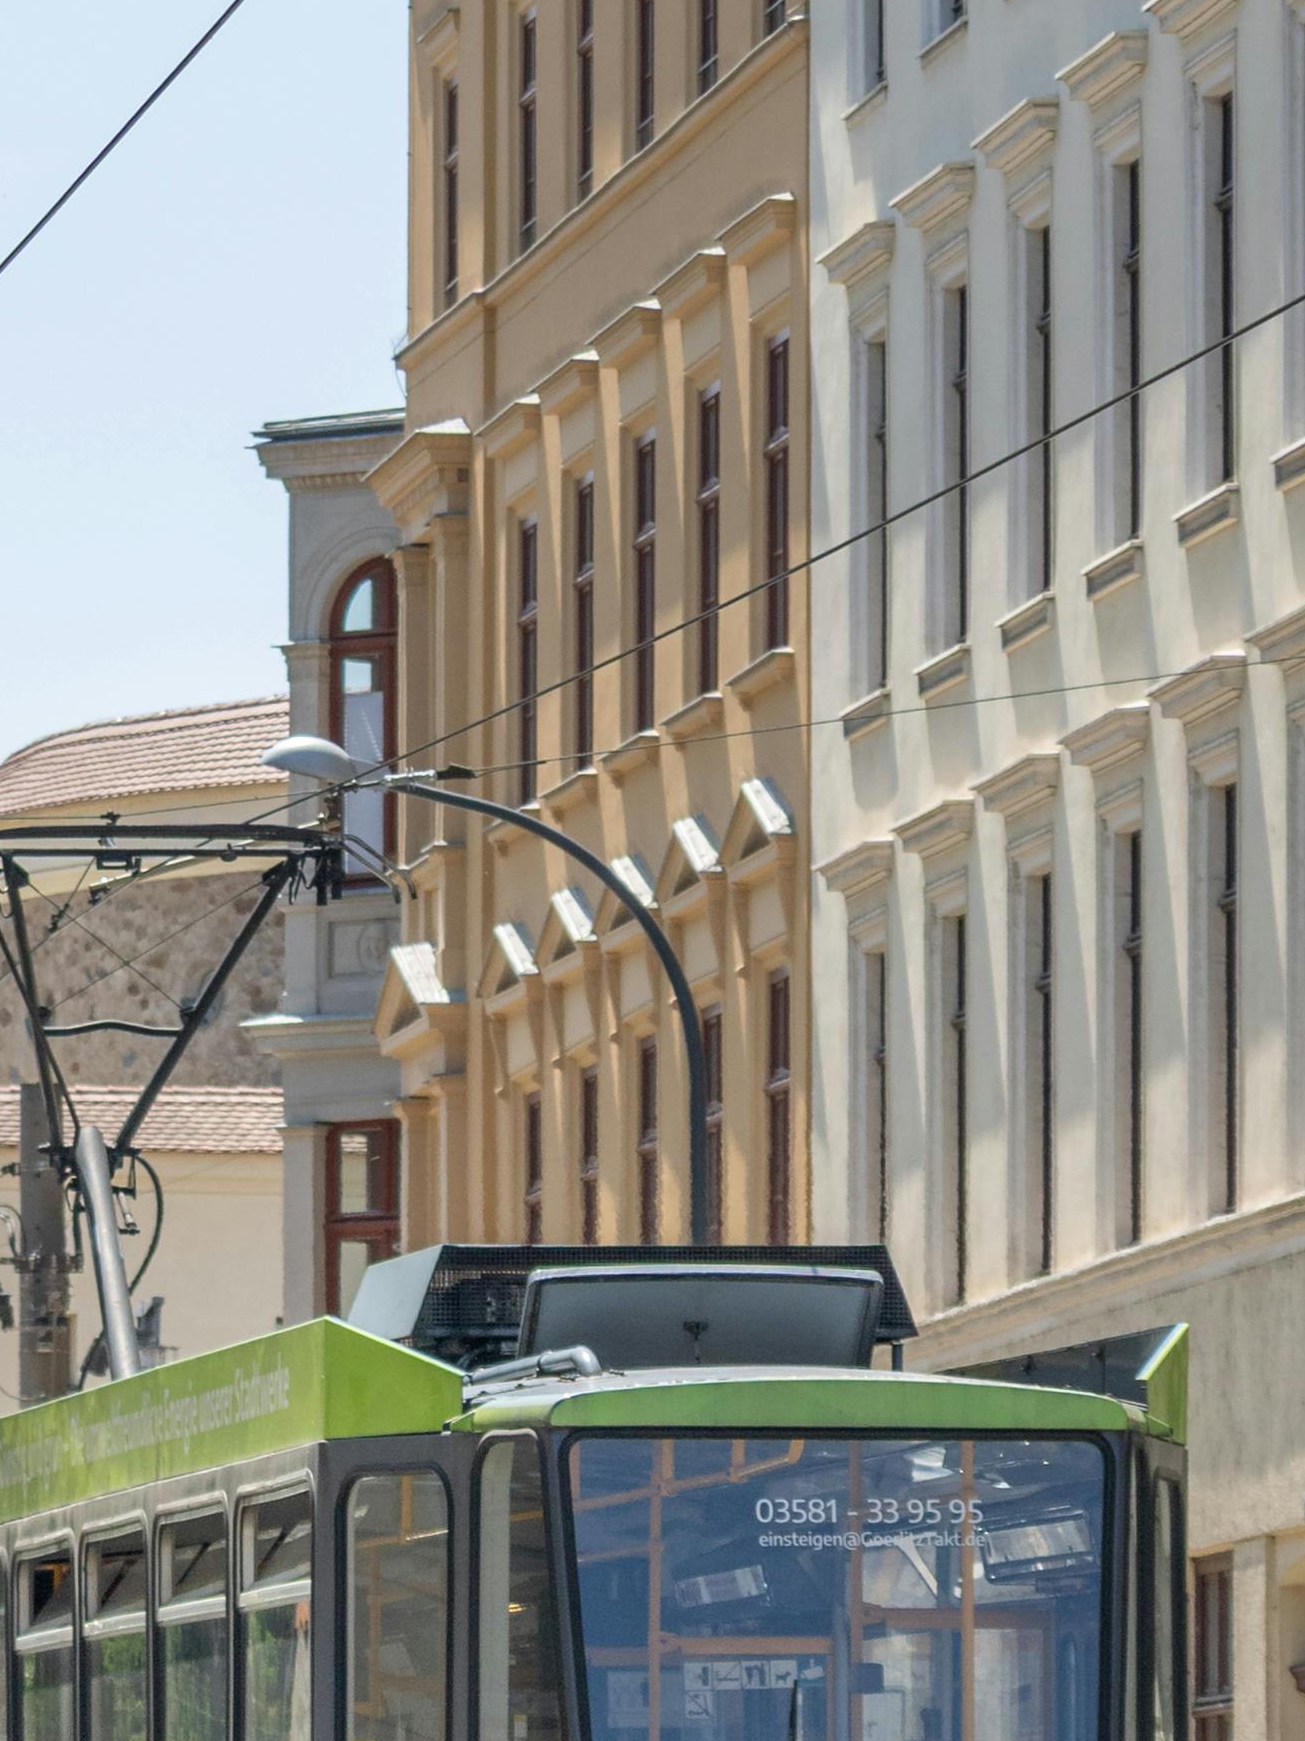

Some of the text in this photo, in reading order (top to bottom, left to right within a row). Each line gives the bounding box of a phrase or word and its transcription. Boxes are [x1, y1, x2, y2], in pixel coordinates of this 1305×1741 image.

[755, 1498, 838, 1524] 03581
[867, 1498, 900, 1524] 33
[907, 1499, 942, 1524] 95
[948, 1499, 984, 1524] 95
